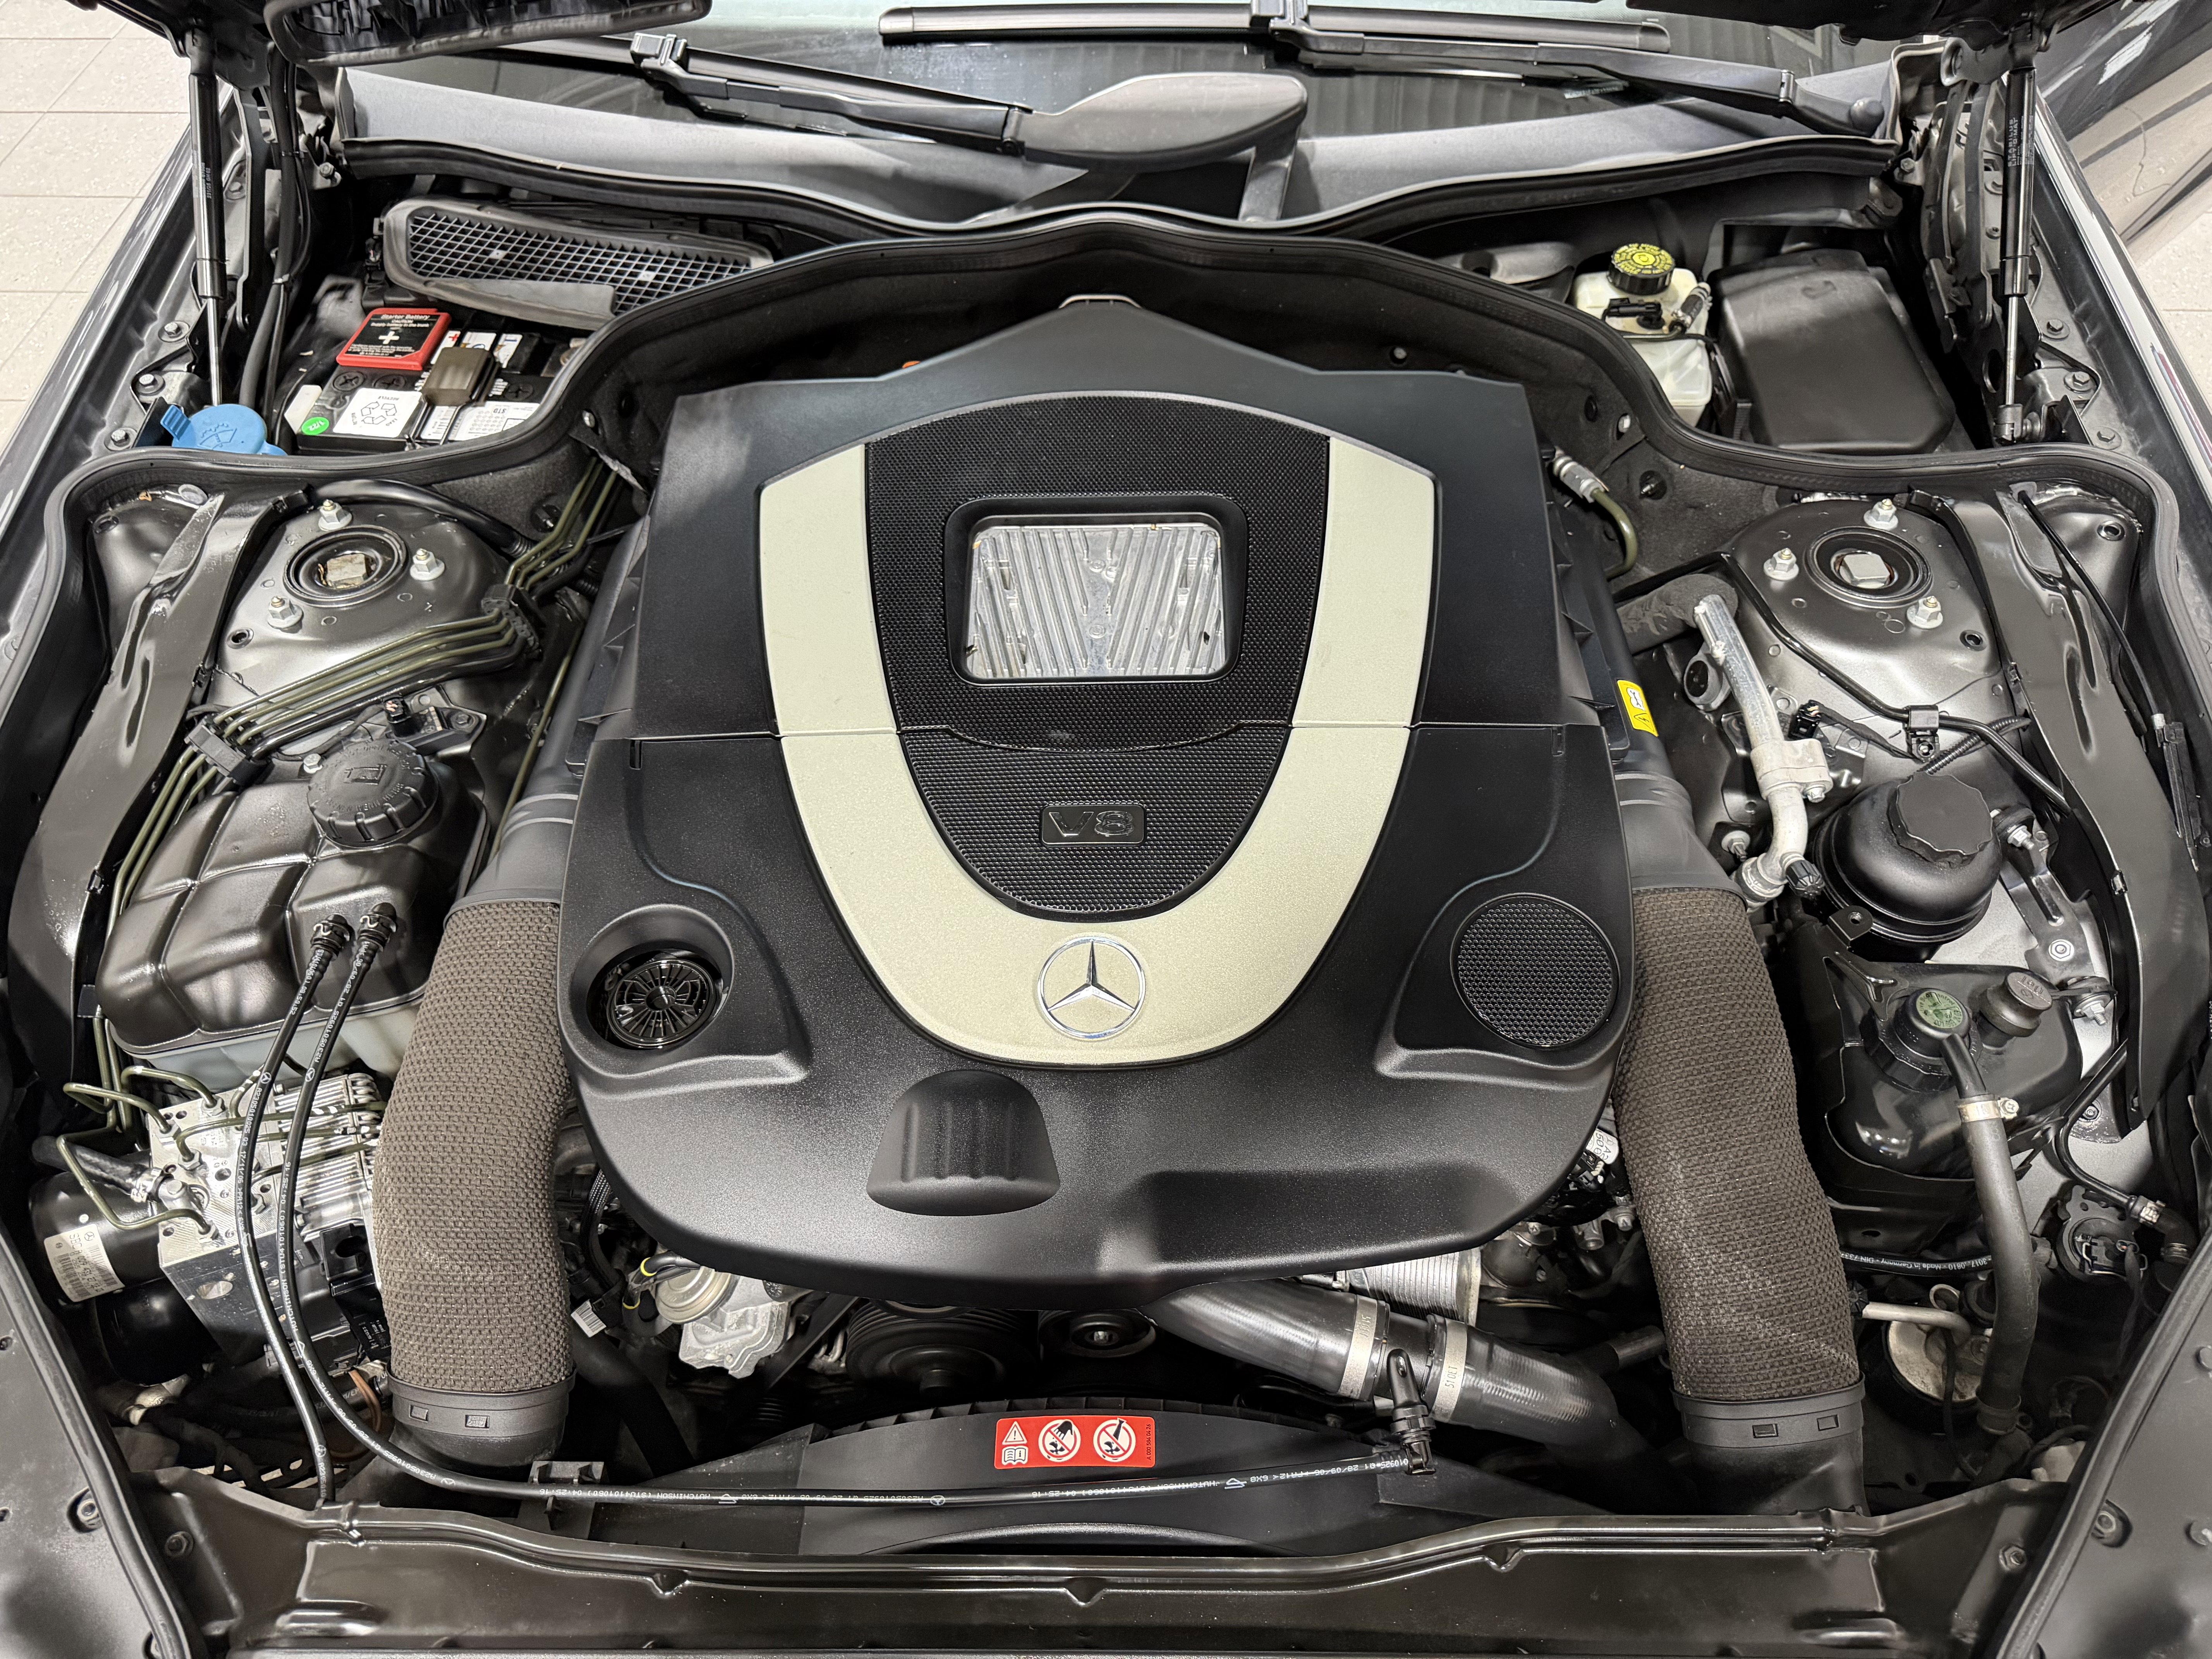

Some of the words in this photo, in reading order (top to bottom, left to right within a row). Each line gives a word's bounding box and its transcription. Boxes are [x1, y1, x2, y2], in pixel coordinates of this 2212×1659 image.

[1048, 810, 1135, 837] V8
[314, 1010, 340, 1063] A2305010925
[244, 1087, 263, 1134] A2305010025
[241, 1137, 249, 1146] Q3
[237, 1150, 246, 1184] 17/11/06
[69, 1233, 82, 1249] SBC
[1881, 1258, 1912, 1268] Germany
[282, 1279, 299, 1331] HUTCHINSON
[382, 1450, 437, 1480] A2305010925
